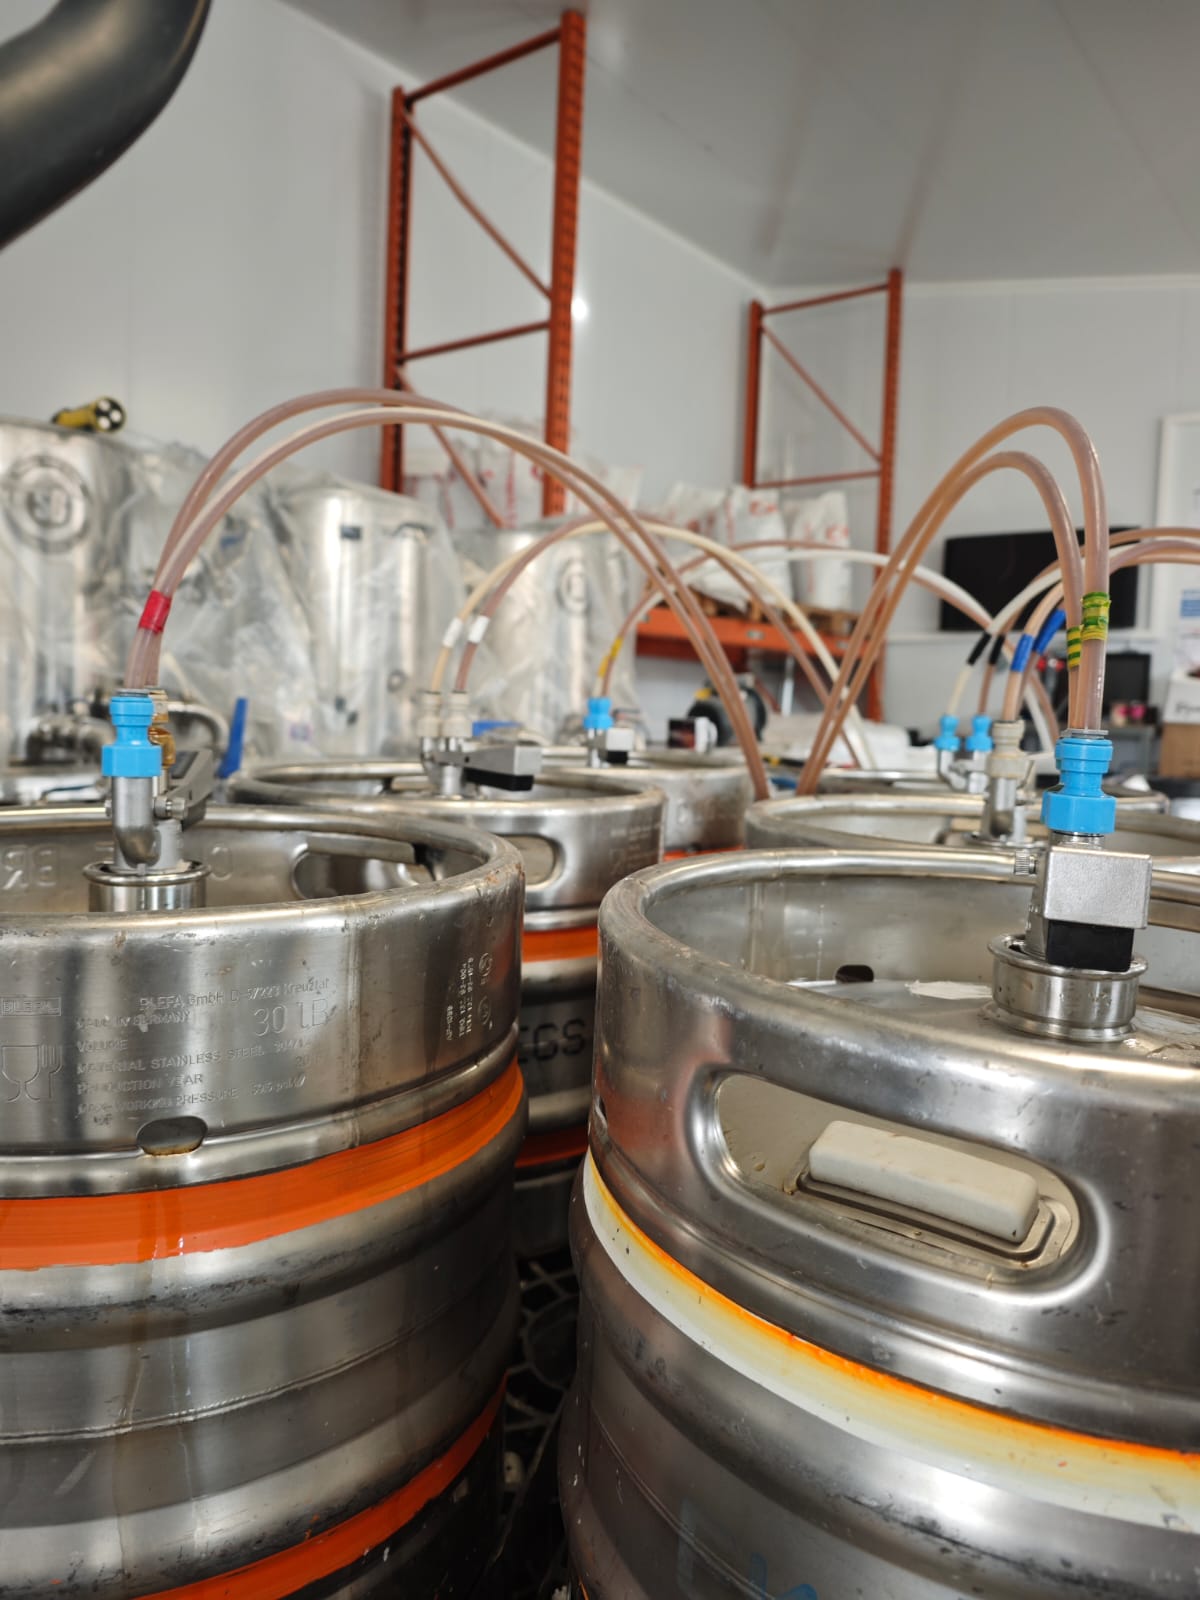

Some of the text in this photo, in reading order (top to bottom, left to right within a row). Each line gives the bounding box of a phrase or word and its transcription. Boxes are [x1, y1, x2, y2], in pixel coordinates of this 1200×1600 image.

[254, 1003, 288, 1037] 30
[150, 1049, 221, 1069] STAINLESS
[226, 1044, 264, 1060] STEEL
[167, 1072, 203, 1088] YEAR
[175, 1087, 239, 1106] PRESSURE
